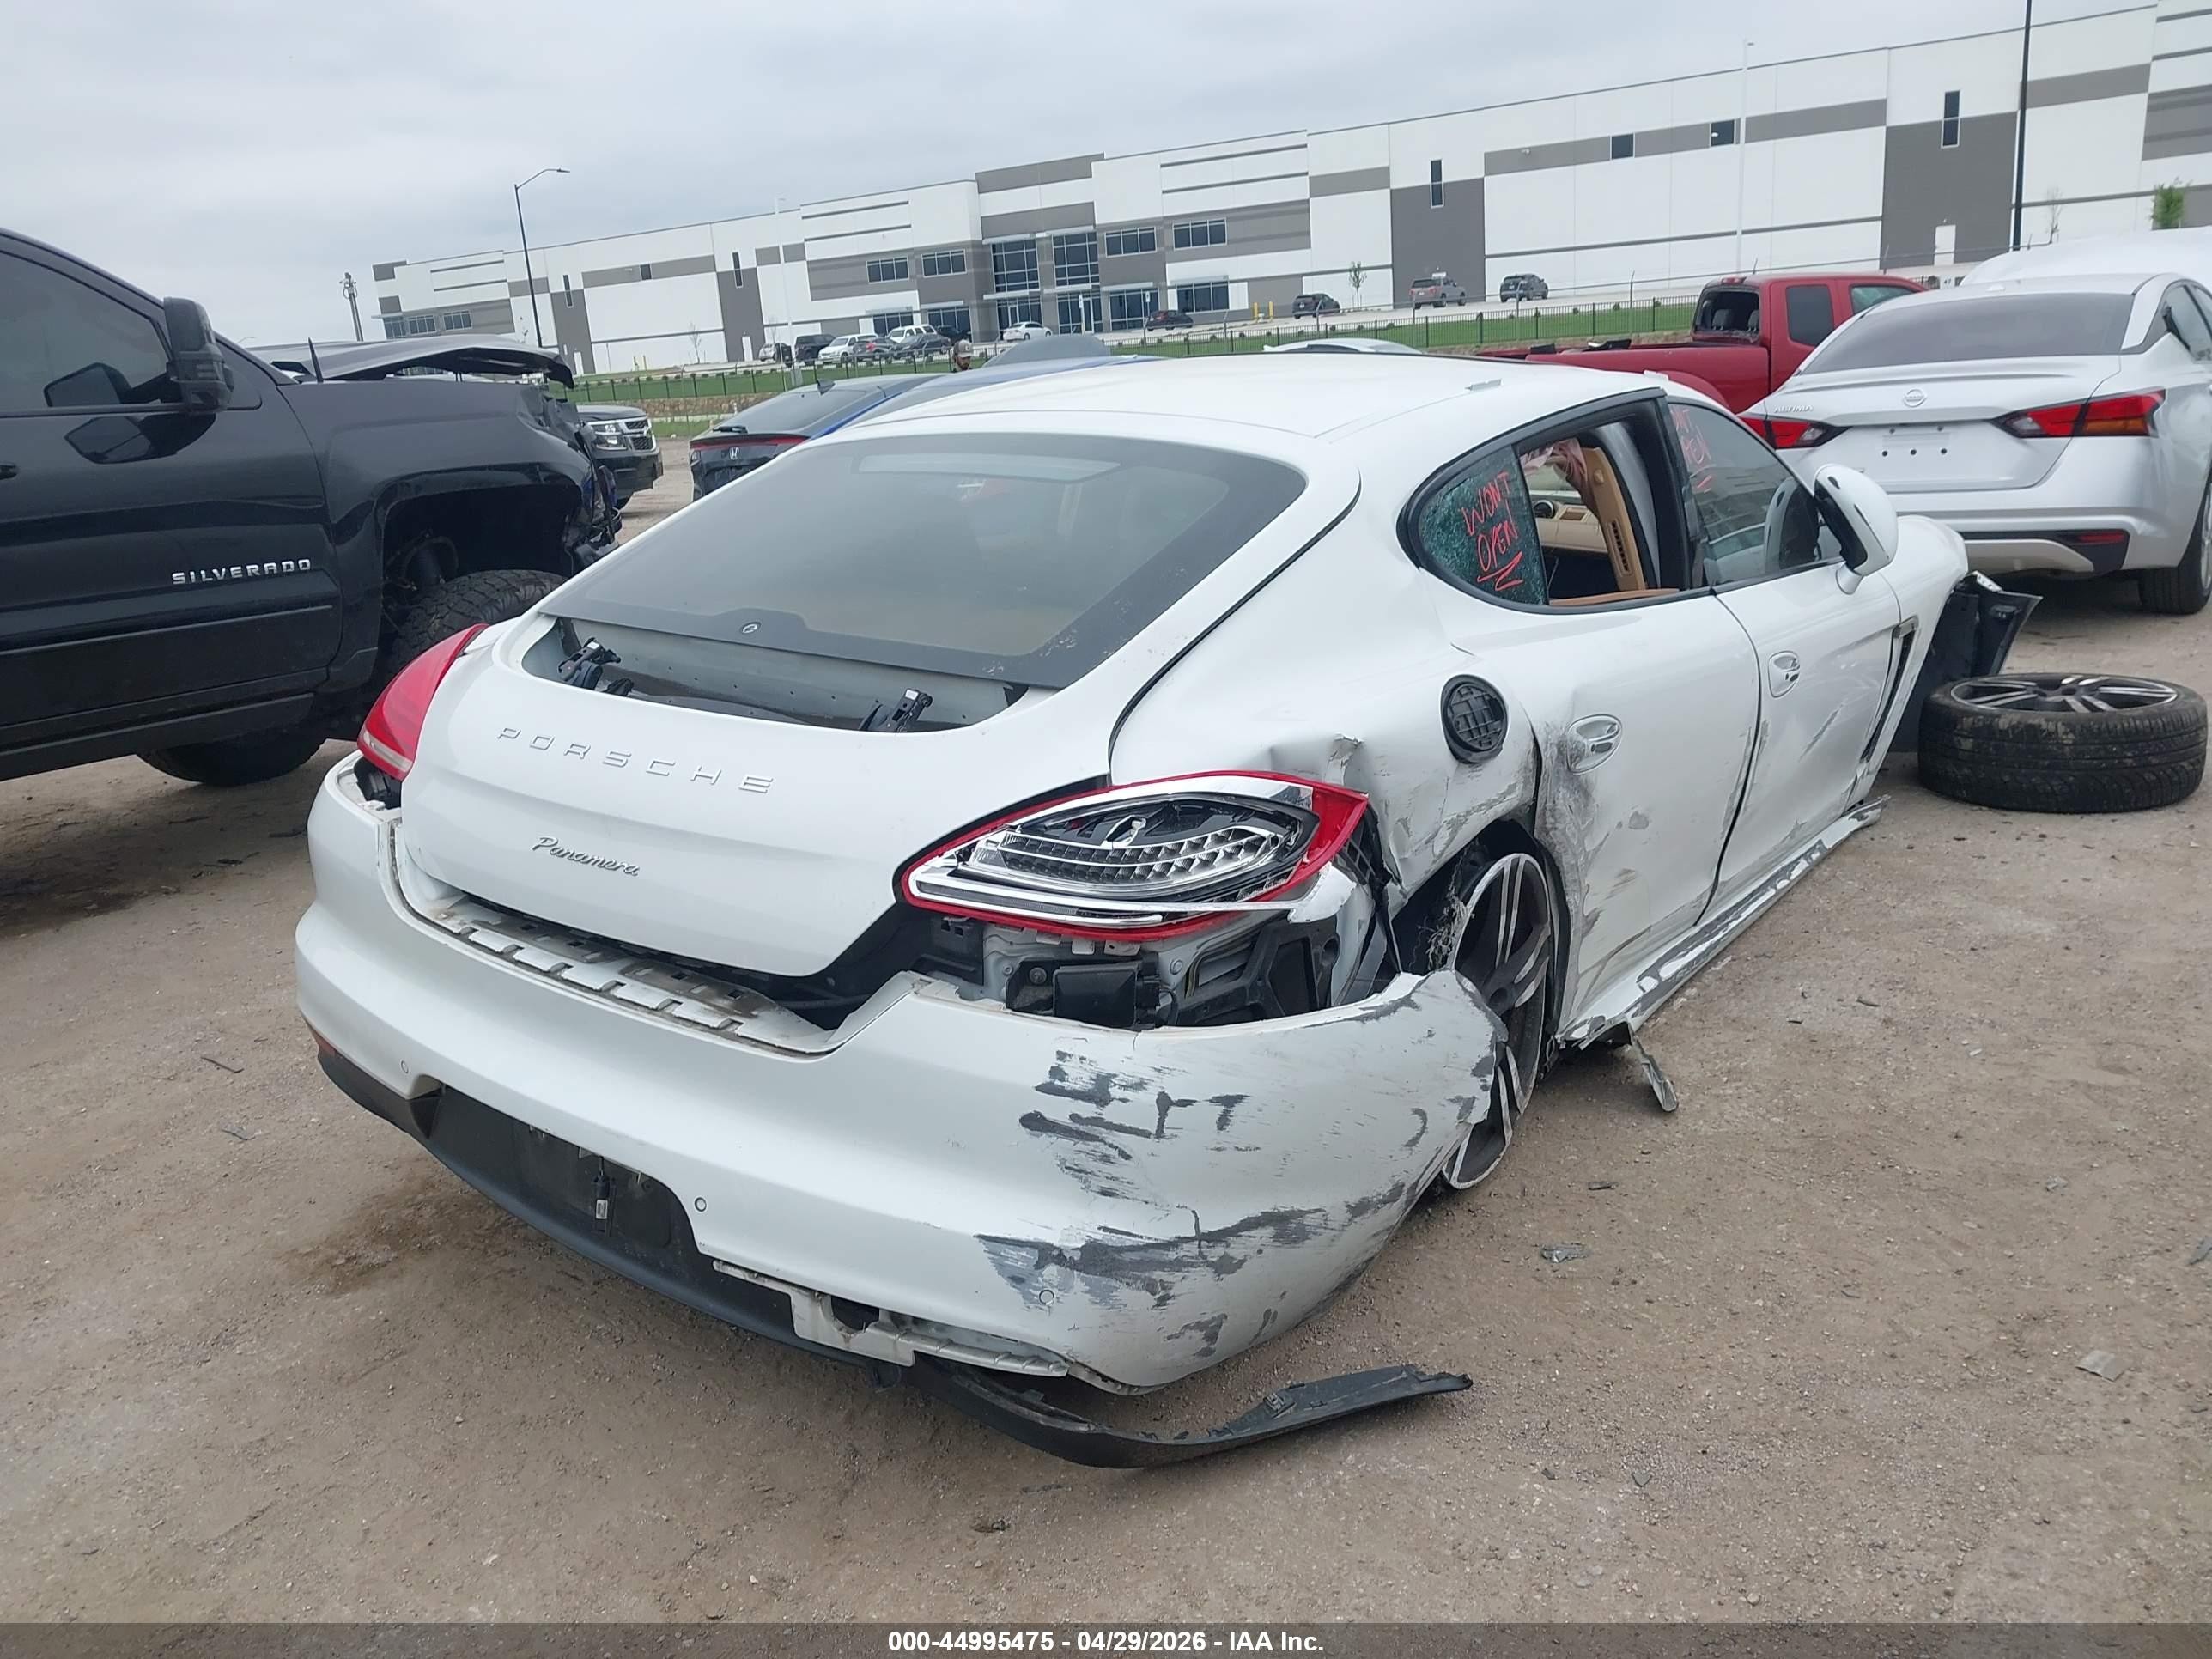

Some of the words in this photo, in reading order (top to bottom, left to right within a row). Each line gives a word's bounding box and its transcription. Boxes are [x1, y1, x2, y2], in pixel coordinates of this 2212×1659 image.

[1477, 497, 1519, 572] OPEN
[172, 558, 311, 586] SILVERADO
[496, 726, 775, 795] PORSCHE
[532, 836, 641, 878] Panamera
